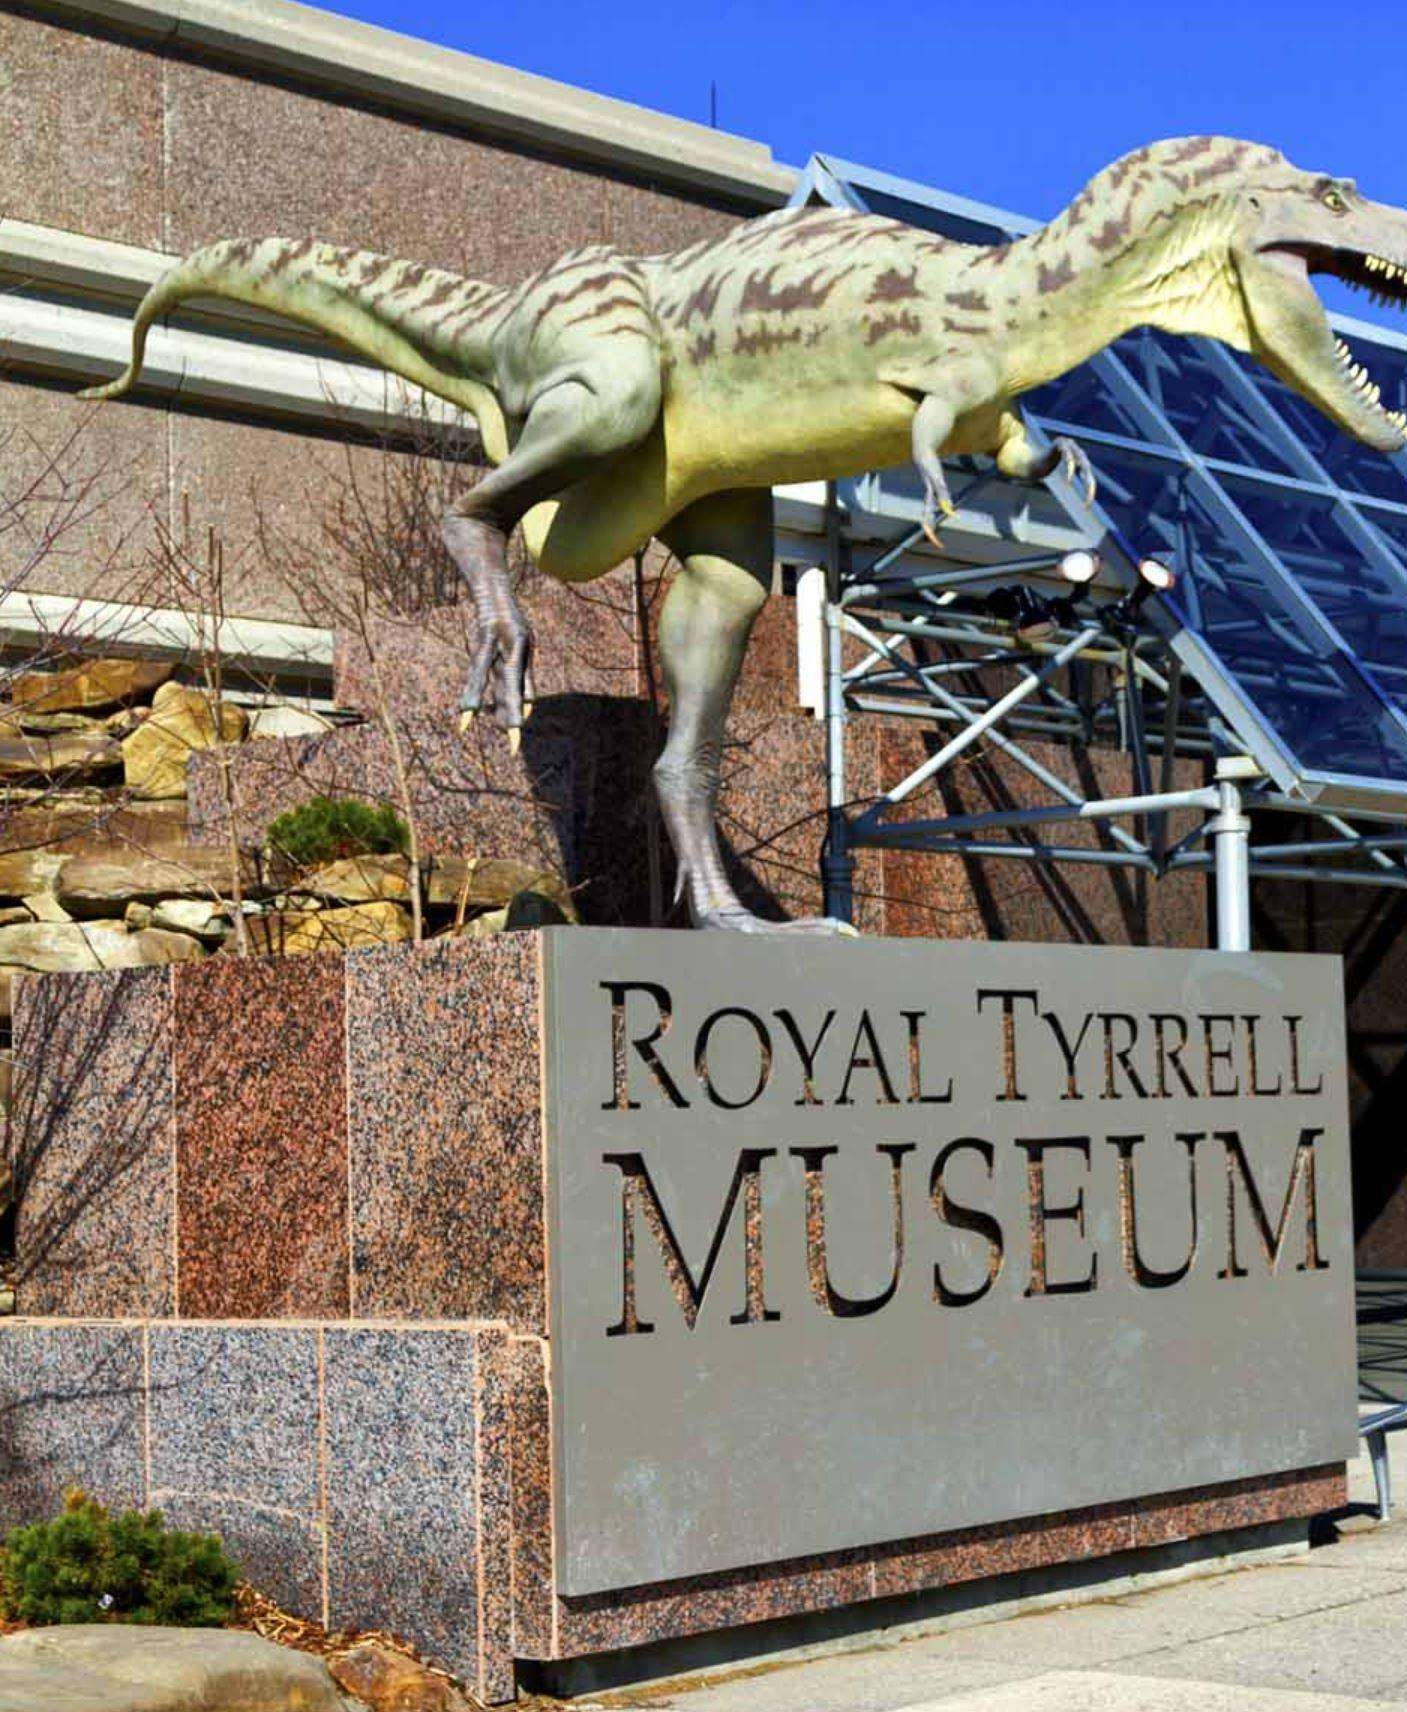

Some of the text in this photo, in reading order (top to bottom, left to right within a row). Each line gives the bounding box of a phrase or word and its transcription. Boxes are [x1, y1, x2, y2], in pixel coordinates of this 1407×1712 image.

[600, 980, 1324, 1111] ROYAL TYRRELL
[602, 1127, 1331, 1338] MUSEUM
